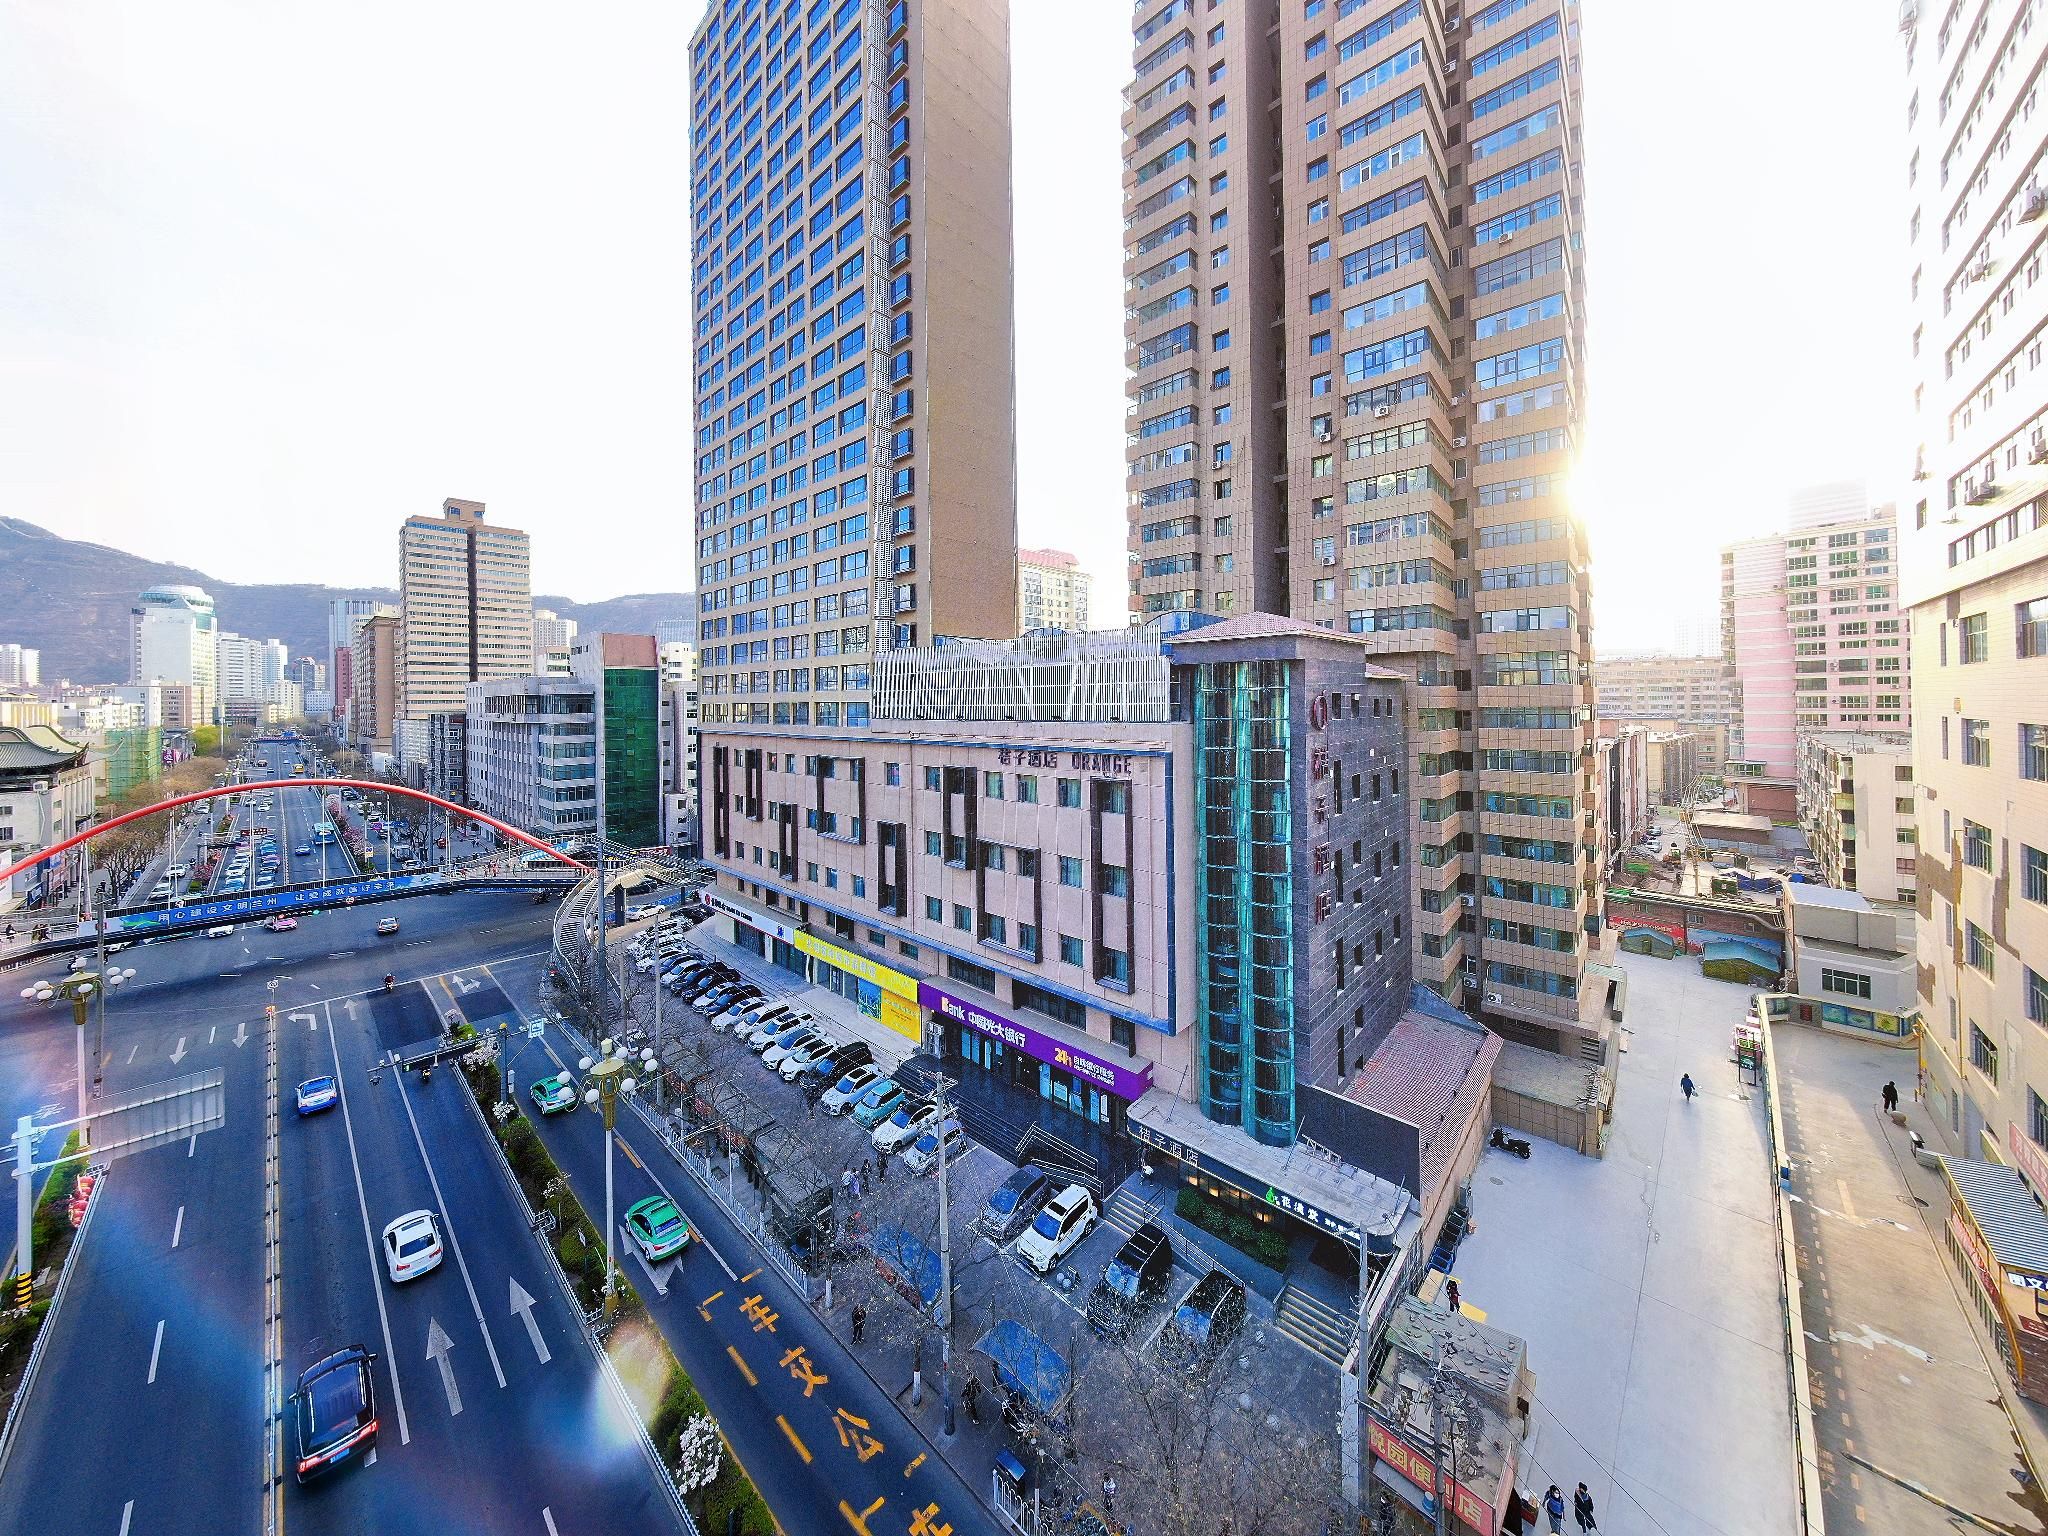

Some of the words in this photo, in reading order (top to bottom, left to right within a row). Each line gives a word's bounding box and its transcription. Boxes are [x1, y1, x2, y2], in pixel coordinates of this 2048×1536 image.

[998, 749, 1058, 769] 桔子酒店
[1071, 752, 1132, 775] ORANGE
[158, 897, 278, 922] 用心建设文明兰州
[941, 996, 965, 1020] Bank
[968, 1011, 1026, 1048] 中国光大银行
[1138, 1125, 1199, 1168] 桔子酒店
